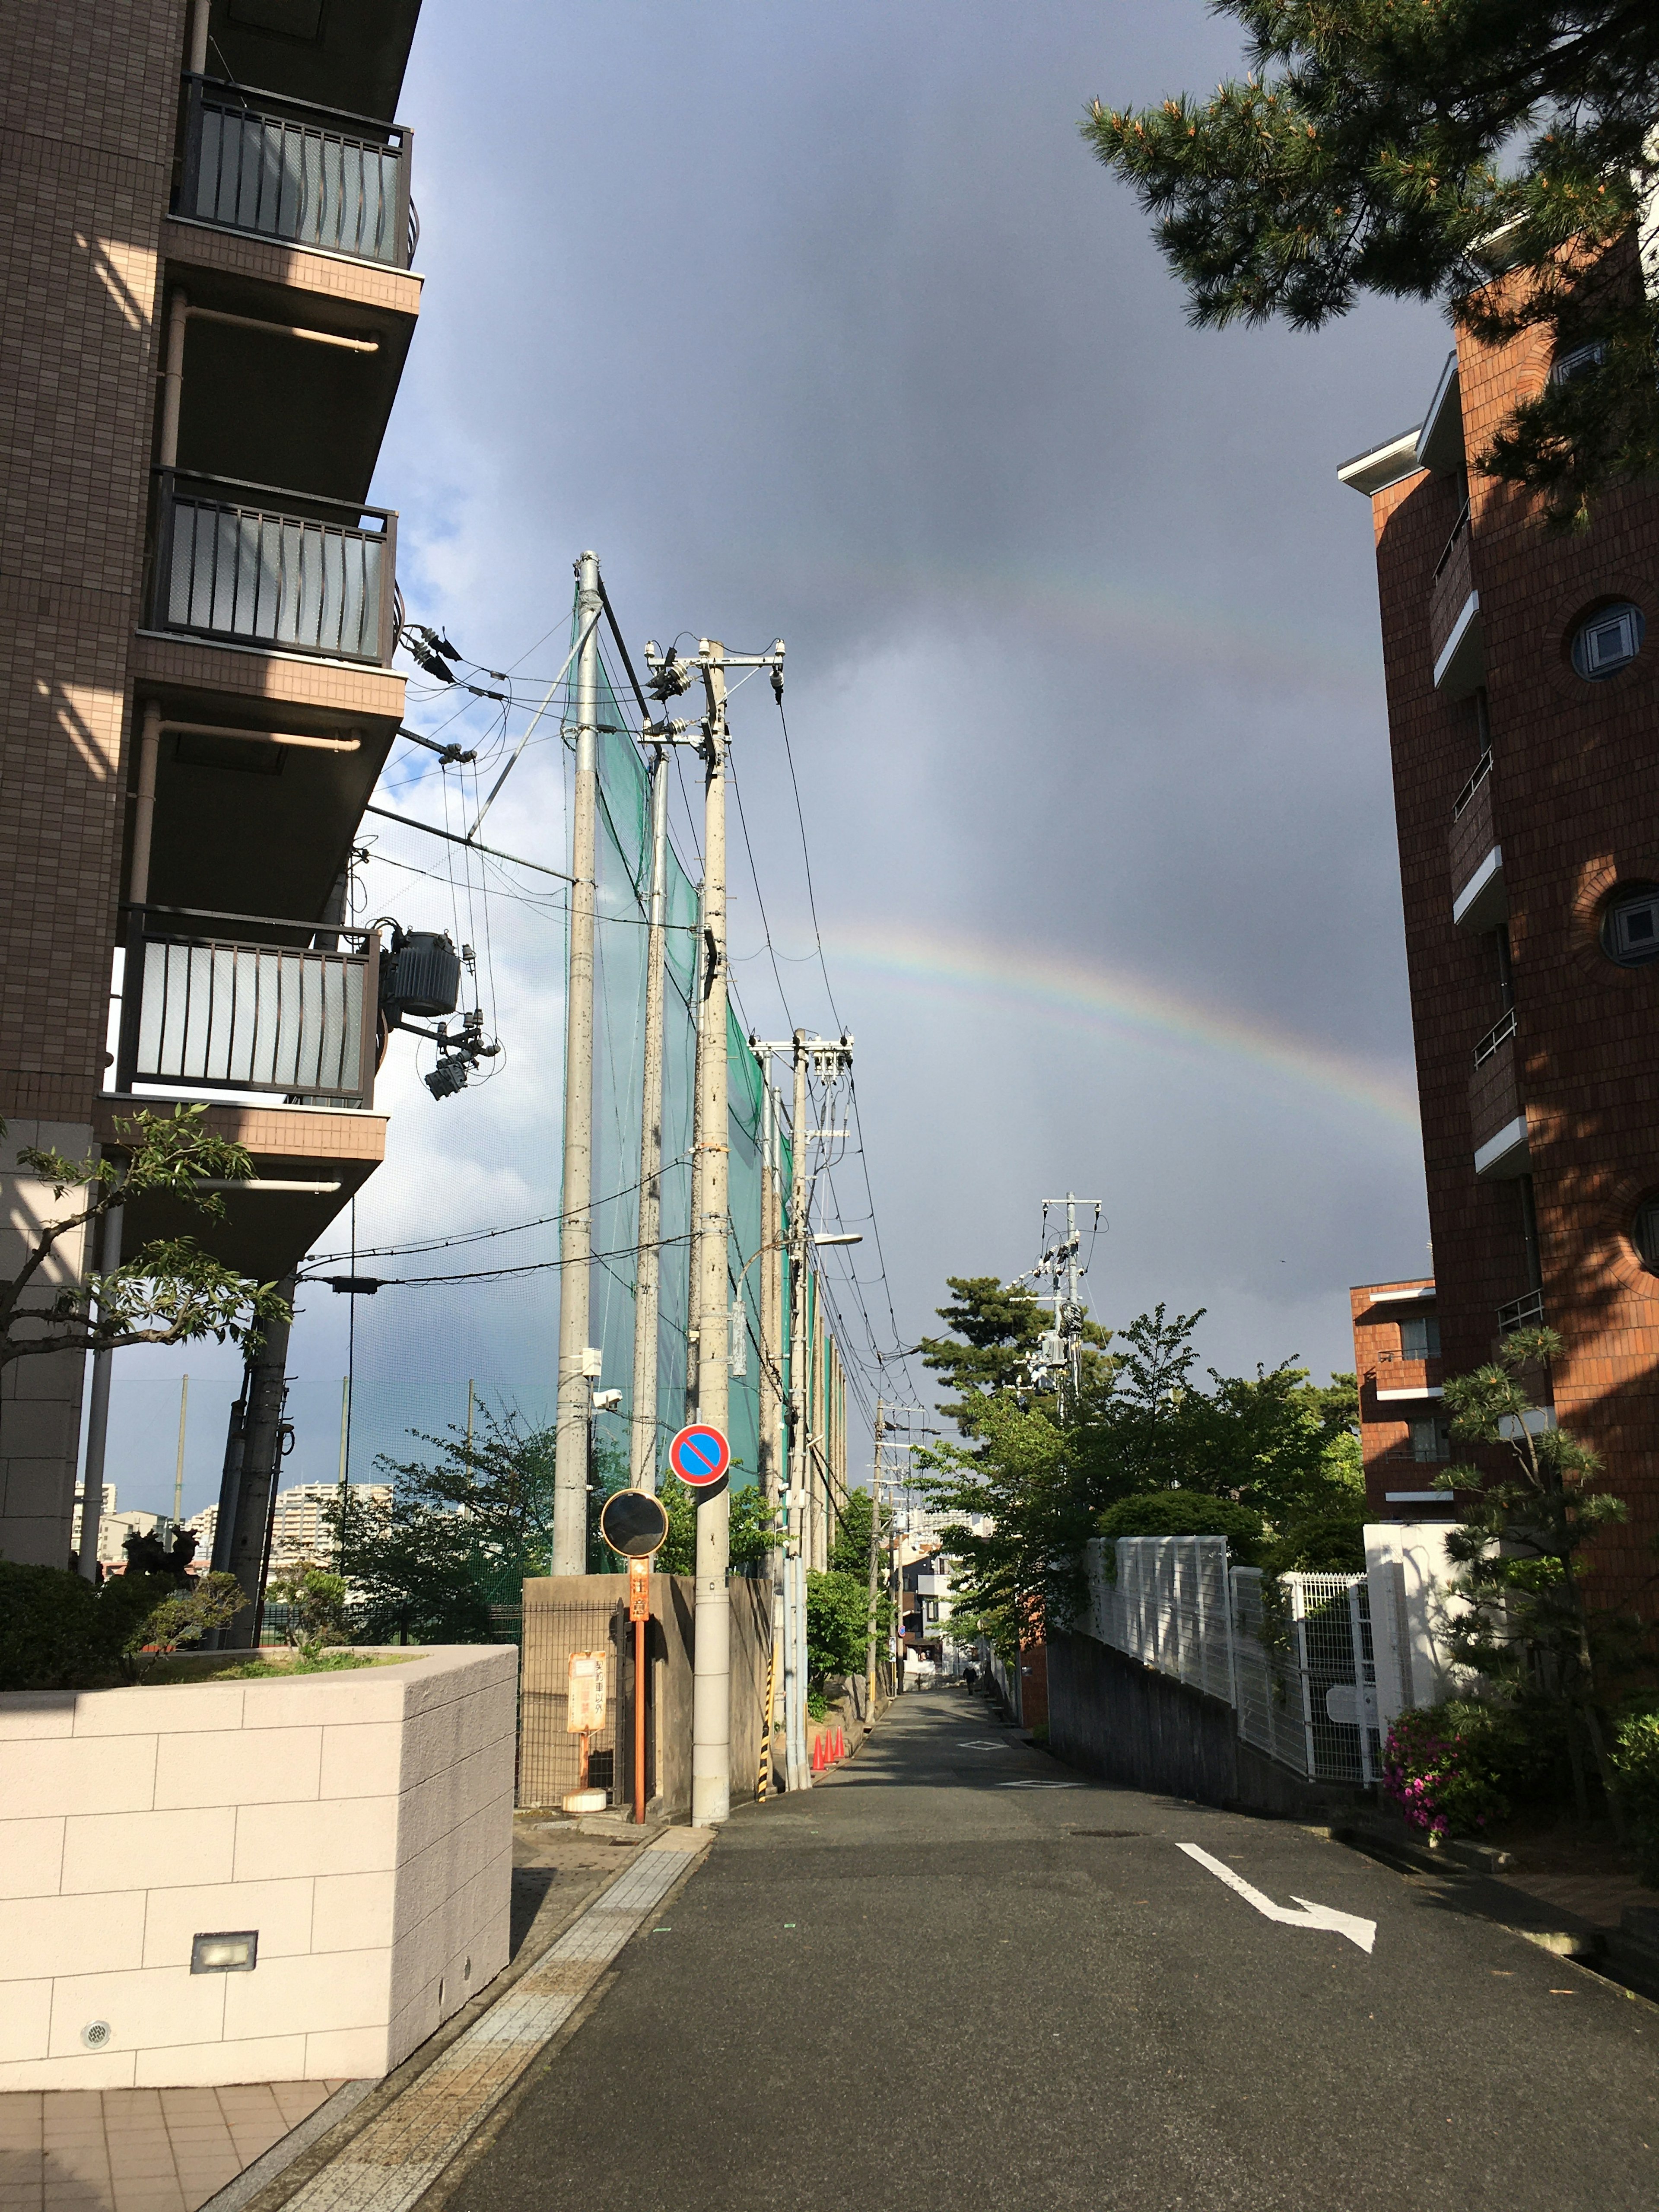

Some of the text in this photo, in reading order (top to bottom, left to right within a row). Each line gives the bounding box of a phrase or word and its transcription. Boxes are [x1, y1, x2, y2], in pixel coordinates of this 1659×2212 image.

[633, 1579, 646, 1615] 注意
[581, 1680, 589, 1725] 車禁止
